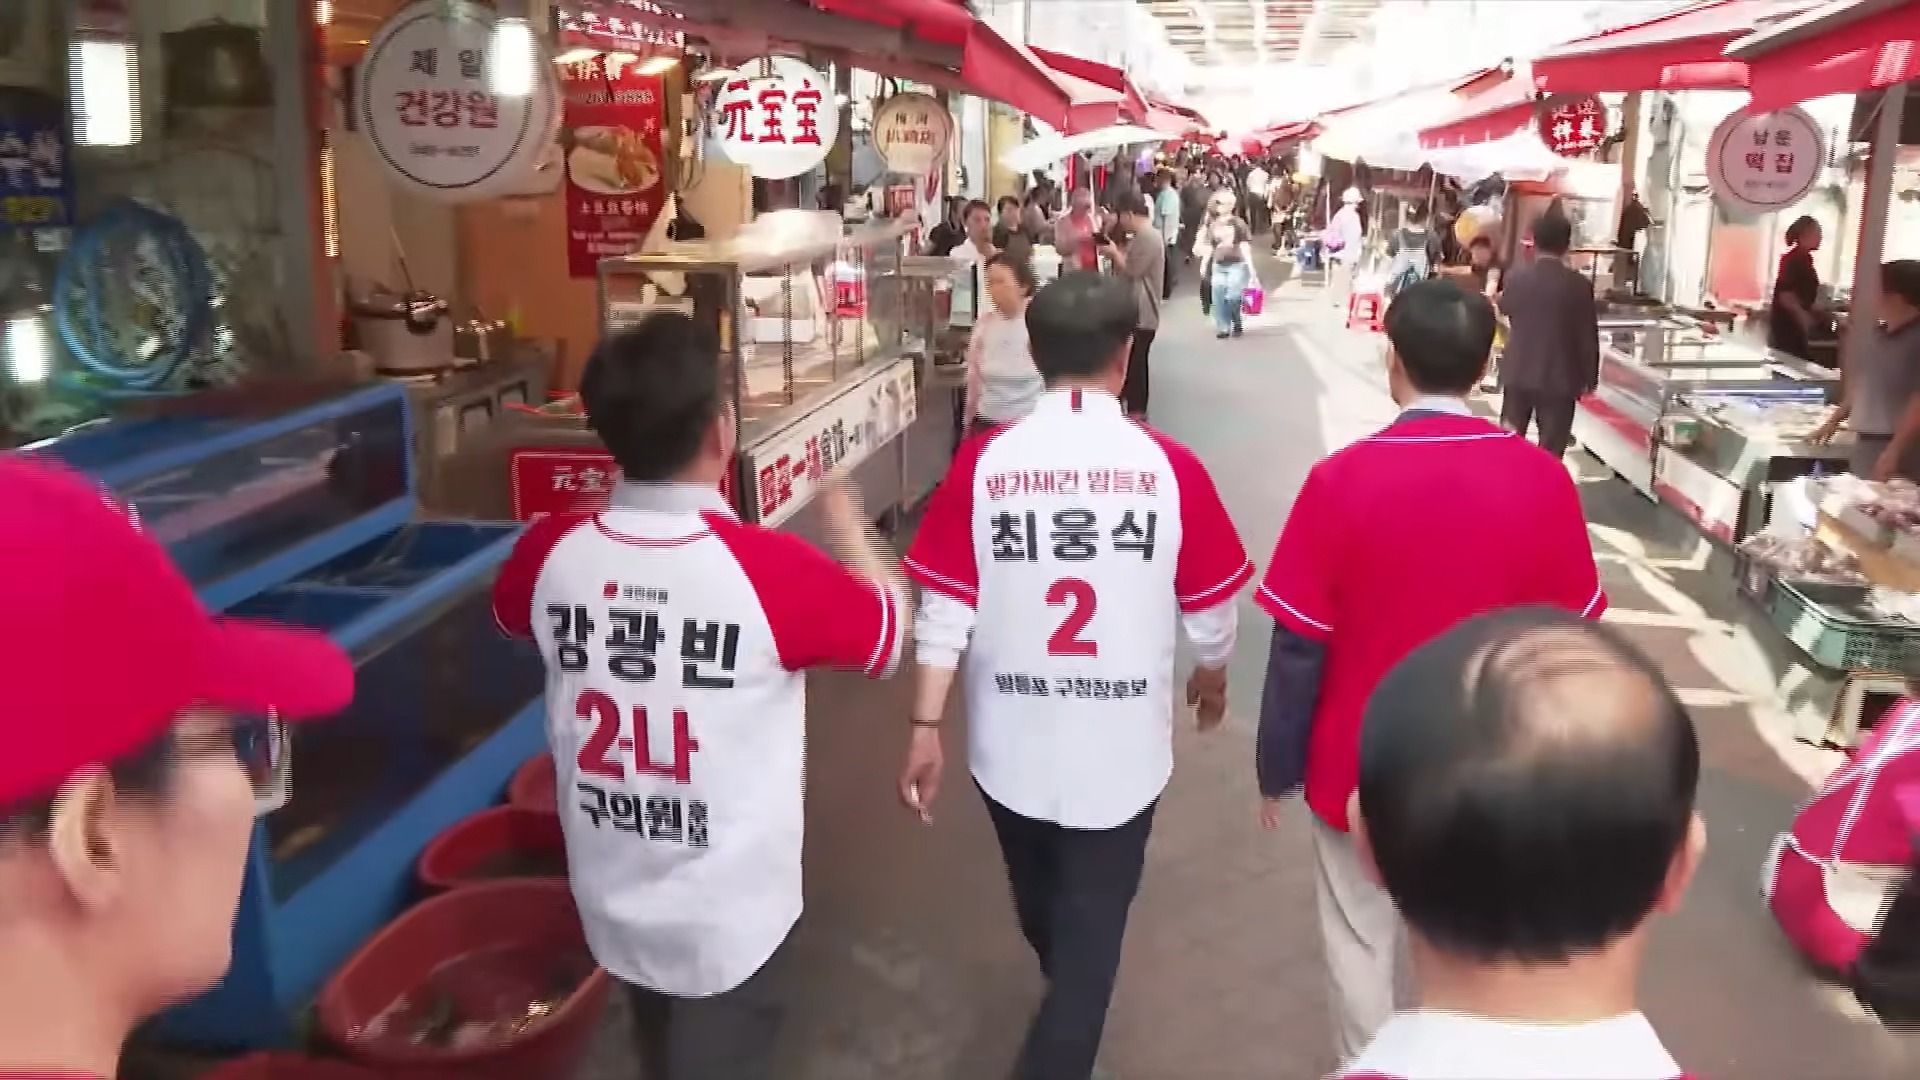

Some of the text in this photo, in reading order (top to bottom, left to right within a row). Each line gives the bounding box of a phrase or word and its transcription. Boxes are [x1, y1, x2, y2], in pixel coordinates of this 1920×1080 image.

[396, 90, 498, 128] 건강원
[723, 79, 822, 146] 元宝宝
[1745, 151, 1794, 174] 떡집
[986, 468, 1157, 500] 명가재건 영등포
[991, 508, 1157, 562] 최웅식
[1045, 576, 1098, 658] 2
[546, 604, 740, 689] 강광빈
[995, 673, 1049, 696] 영등포
[576, 688, 698, 784] 2-나
[577, 781, 682, 843] 구의원
